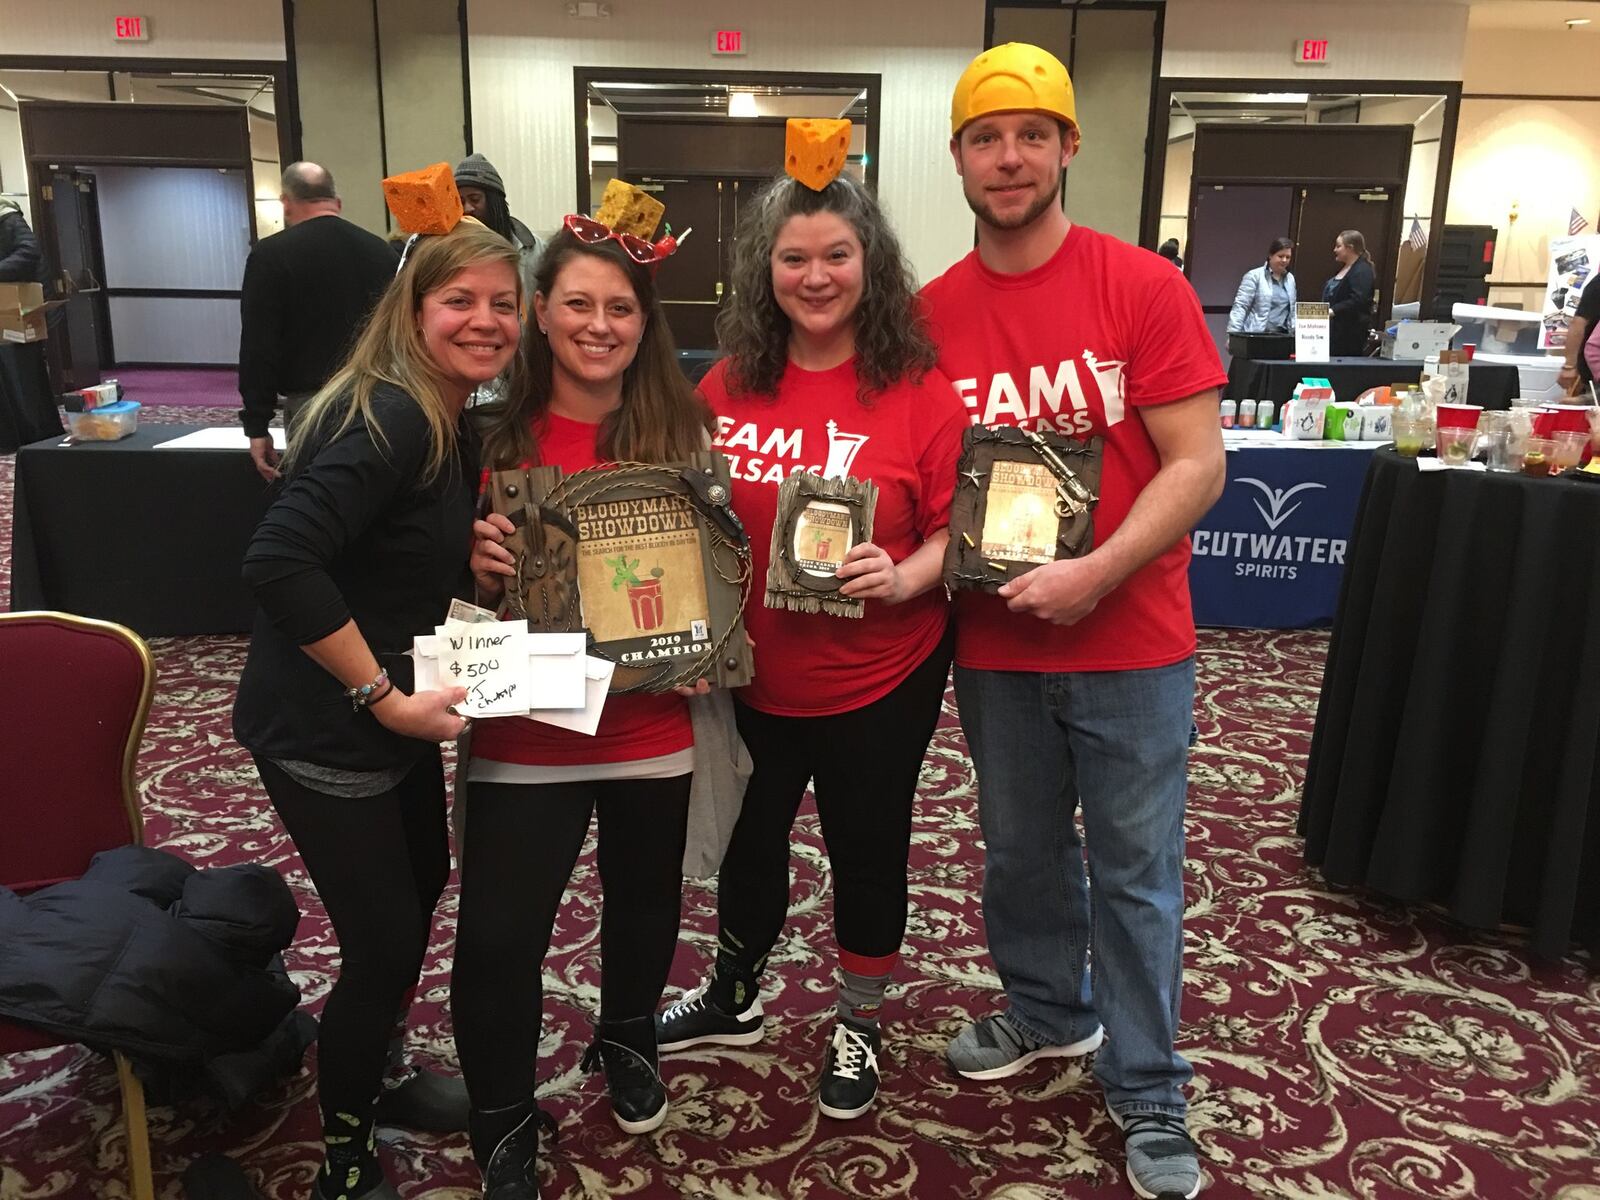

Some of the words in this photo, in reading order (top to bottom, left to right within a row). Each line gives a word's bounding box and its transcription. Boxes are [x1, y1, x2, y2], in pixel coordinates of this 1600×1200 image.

[115, 17, 141, 37] EXIT
[717, 31, 742, 51] EXIT
[1302, 40, 1329, 60] EXIT
[952, 359, 1089, 426] EAM
[711, 416, 803, 459] EAM
[577, 495, 692, 521] BLOODYMARY
[579, 511, 695, 540] SHOWDOWN
[1191, 530, 1348, 564] CUTWATER
[1235, 563, 1298, 580] SPIRITS
[650, 635, 681, 647] 2019
[621, 642, 713, 662] CHAMPION
